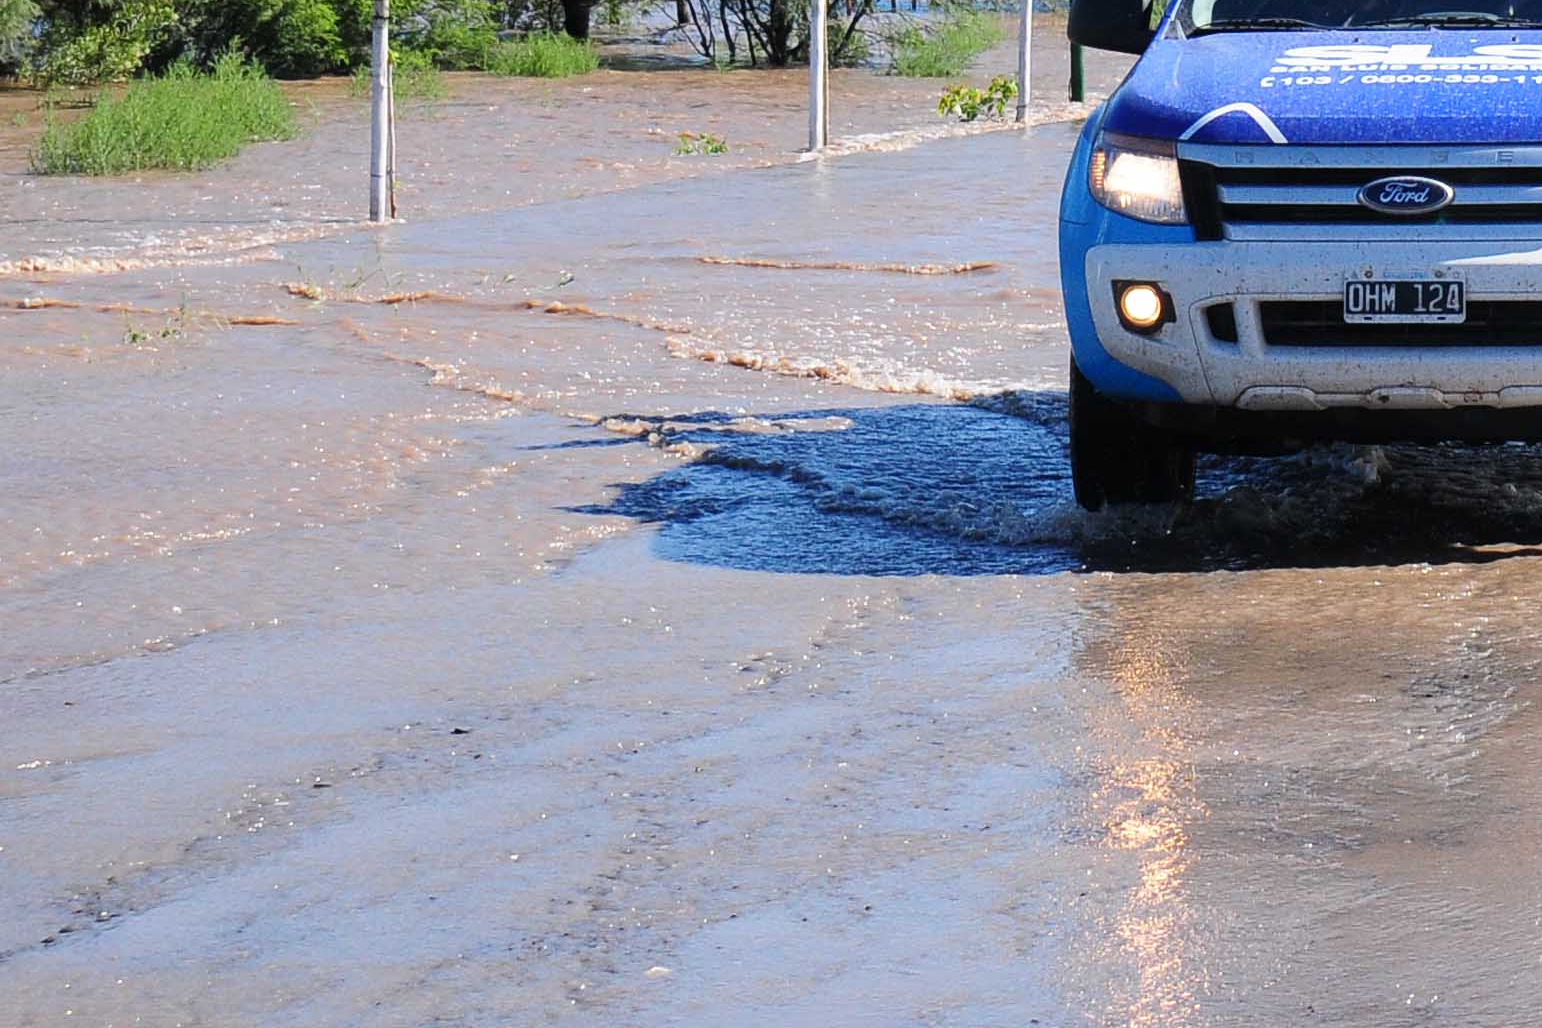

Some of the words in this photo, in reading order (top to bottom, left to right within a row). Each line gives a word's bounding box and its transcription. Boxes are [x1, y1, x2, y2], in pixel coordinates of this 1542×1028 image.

[1269, 64, 1331, 73] SAN
[1280, 75, 1332, 86] 103
[1379, 182, 1430, 203] Ford
[1348, 283, 1396, 312] OHM
[1413, 283, 1460, 312] 124
